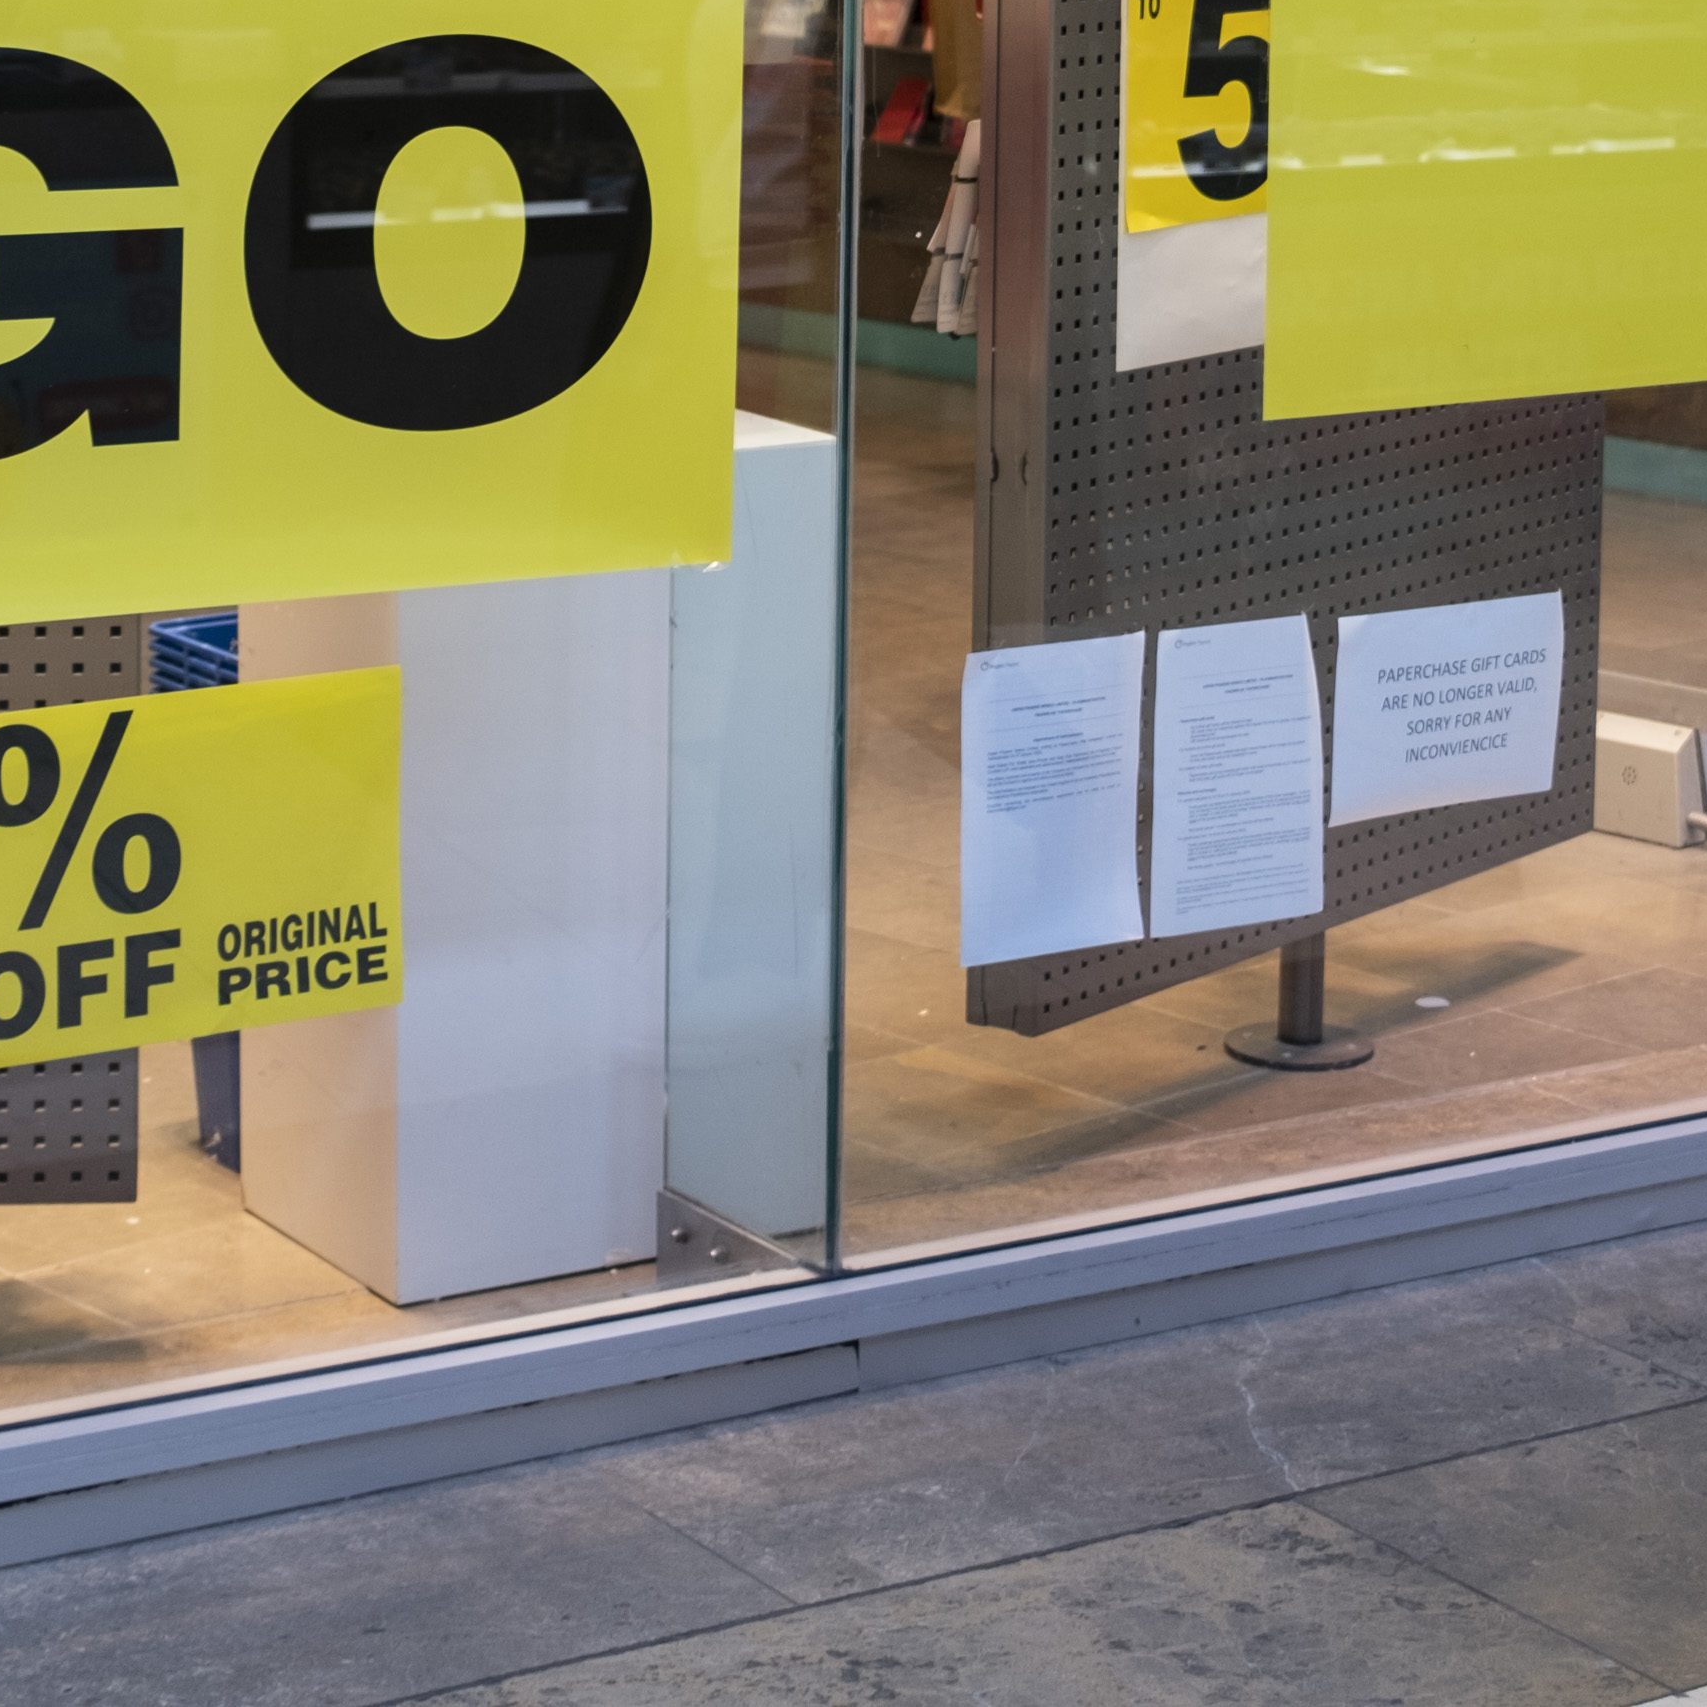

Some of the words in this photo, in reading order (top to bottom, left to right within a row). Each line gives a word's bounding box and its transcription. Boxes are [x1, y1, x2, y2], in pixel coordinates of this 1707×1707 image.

[1378, 659, 1467, 684] PAPERCHASE
[1470, 654, 1501, 674] GIFT
[1503, 647, 1547, 668] CARDS
[1381, 694, 1409, 712] ARE
[1412, 690, 1435, 707] NO
[1438, 683, 1493, 705] LONGER
[1496, 676, 1538, 697] VALID,
[1406, 715, 1451, 736] SORRY
[1454, 711, 1481, 729] FOR
[1483, 706, 1513, 725] ANY
[1405, 732, 1509, 763] INCONVIENCICE
[217, 901, 389, 961] ORIGINAL
[217, 943, 390, 1007] PRICE
